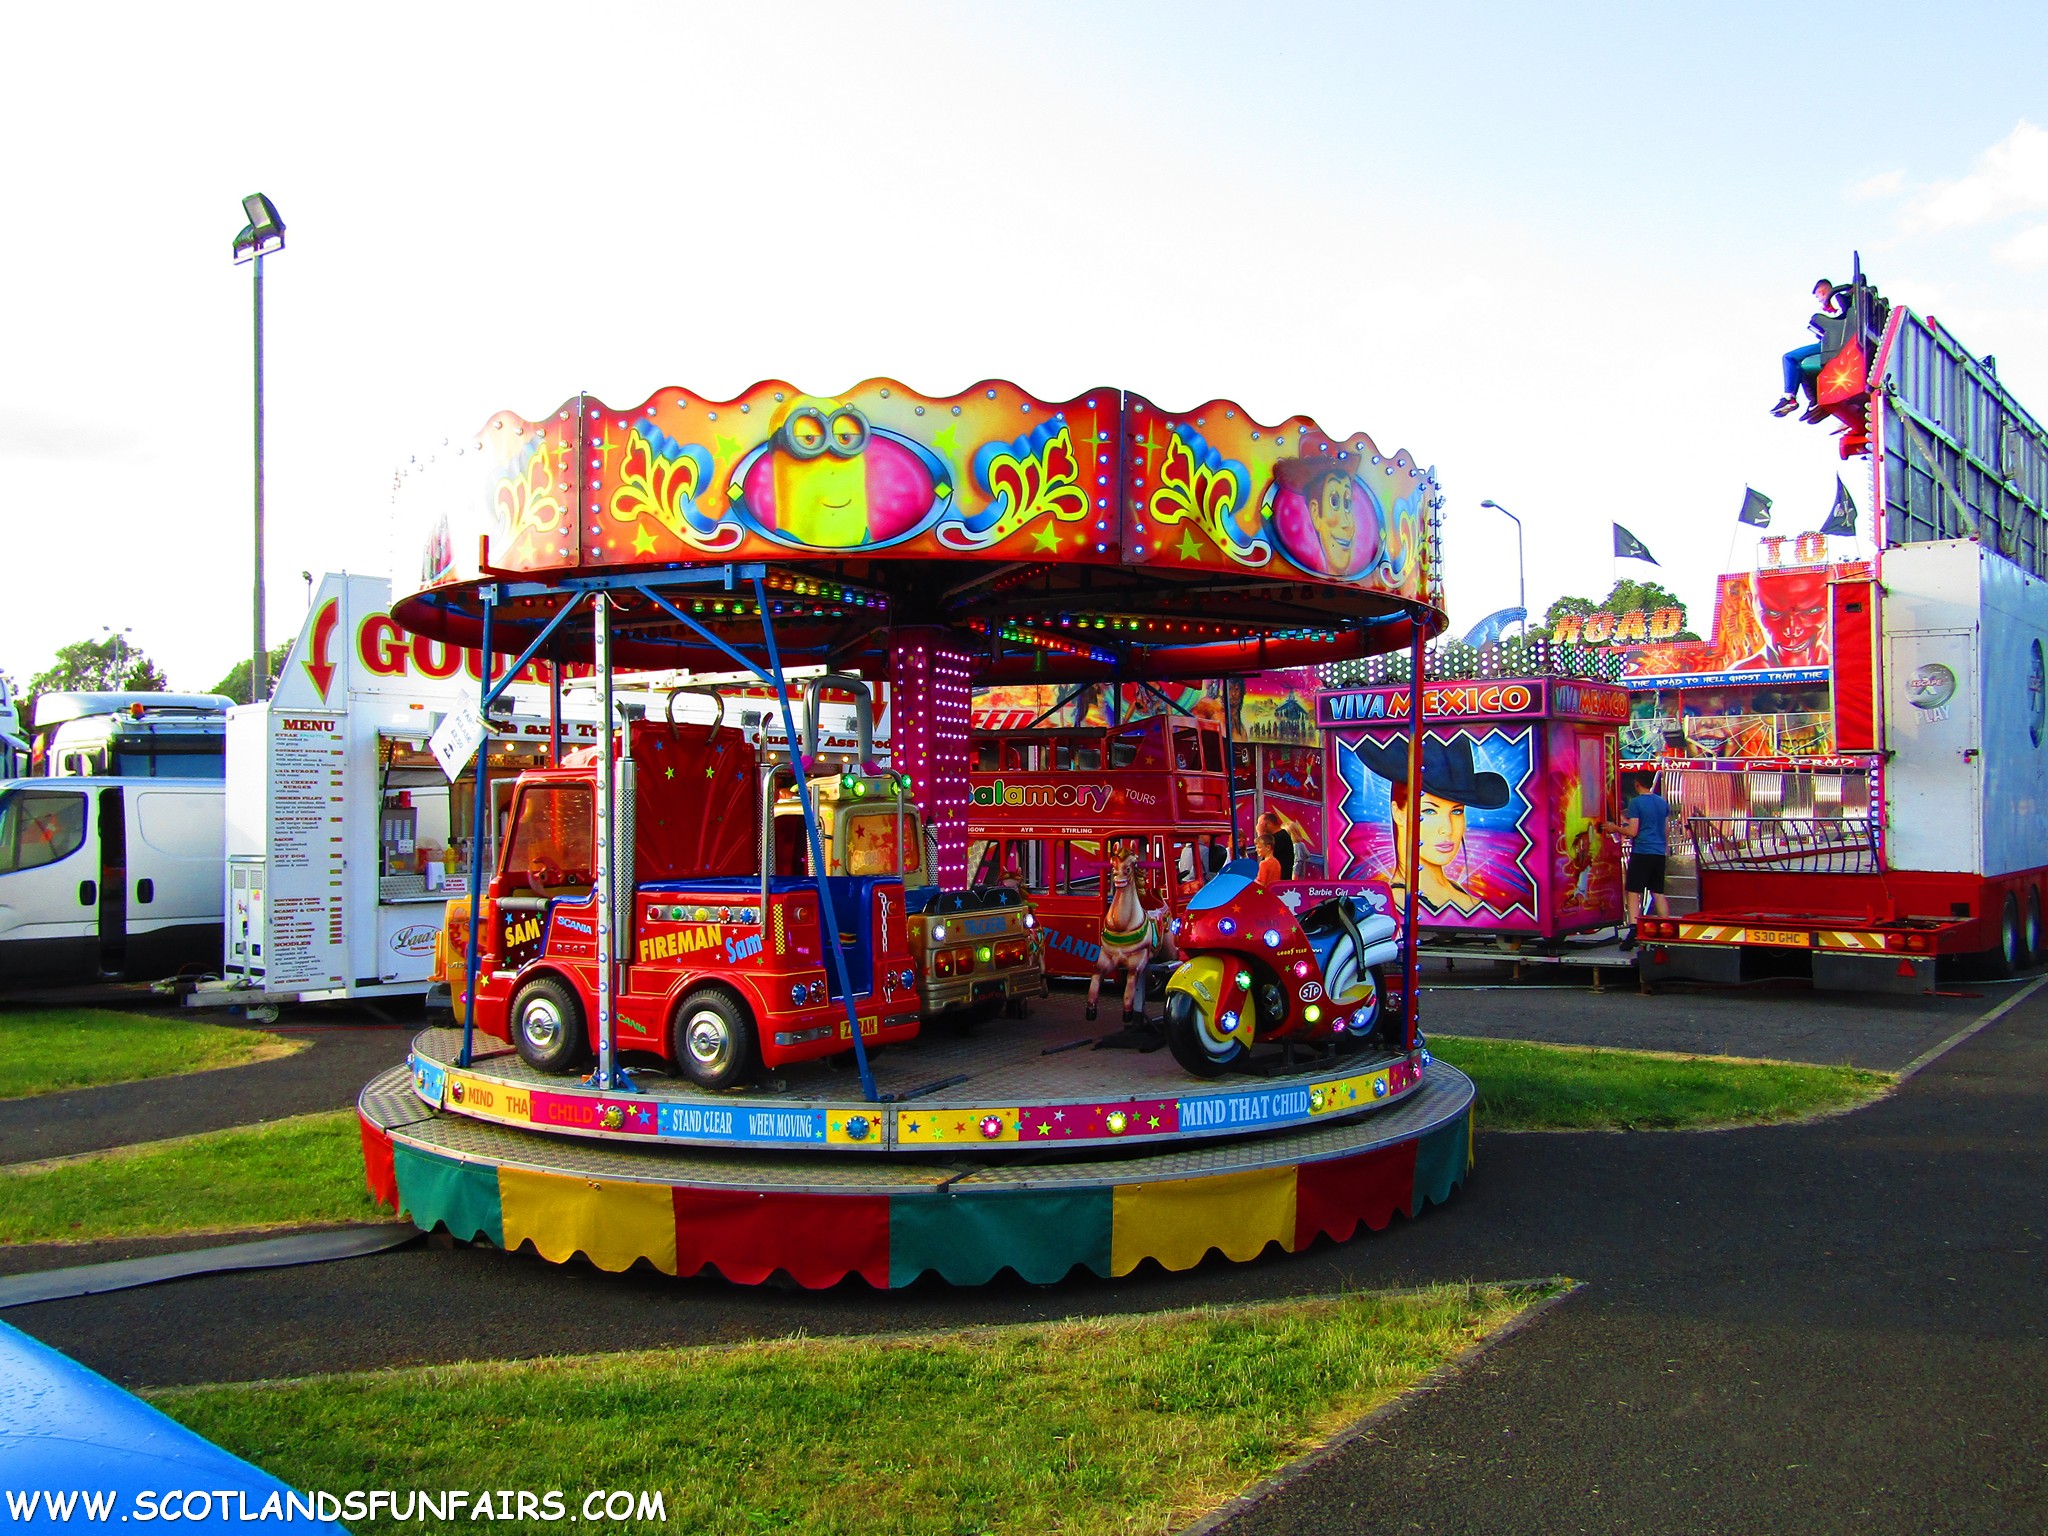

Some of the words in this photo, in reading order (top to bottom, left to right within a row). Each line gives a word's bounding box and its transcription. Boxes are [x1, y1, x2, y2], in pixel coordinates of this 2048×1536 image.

[1760, 531, 1828, 565] TO
[1553, 606, 1685, 644] ROAD
[1656, 677, 1683, 686] ROAD
[1728, 673, 1761, 683] GHOST
[1768, 671, 1797, 680] TRAIN
[1802, 671, 1824, 679] THE
[1329, 693, 1384, 720] VIVA
[1386, 685, 1531, 719] MEXICO
[1555, 686, 1578, 713] VIVA
[1578, 687, 1628, 718] MEXICO
[283, 719, 336, 732] MENU
[1915, 705, 1951, 725] PLAY
[1619, 762, 1644, 770] OST
[1125, 788, 1156, 805] TOURS
[1308, 886, 1332, 897] Barbie
[1336, 887, 1348, 898] Girl
[505, 918, 541, 948] SAM
[557, 916, 592, 935] SCANIA
[640, 924, 722, 963] FIREMAN
[725, 933, 763, 963] Sam
[1042, 926, 1102, 963] TLAND
[1778, 932, 1800, 943] GHC
[1302, 983, 1320, 998] STP
[615, 1013, 648, 1035] CANIA
[844, 1018, 875, 1038] ZRAH
[468, 1086, 494, 1108] MIND
[505, 1096, 536, 1117] THAT
[548, 1102, 594, 1124] CHILD
[1181, 1098, 1227, 1127] MIND
[1228, 1094, 1269, 1122] THAT
[1272, 1090, 1308, 1117] CHILD
[672, 1109, 702, 1133] STAND
[703, 1111, 733, 1134] CLEAR
[749, 1113, 775, 1136] WHEN
[776, 1114, 813, 1138] MOVING
